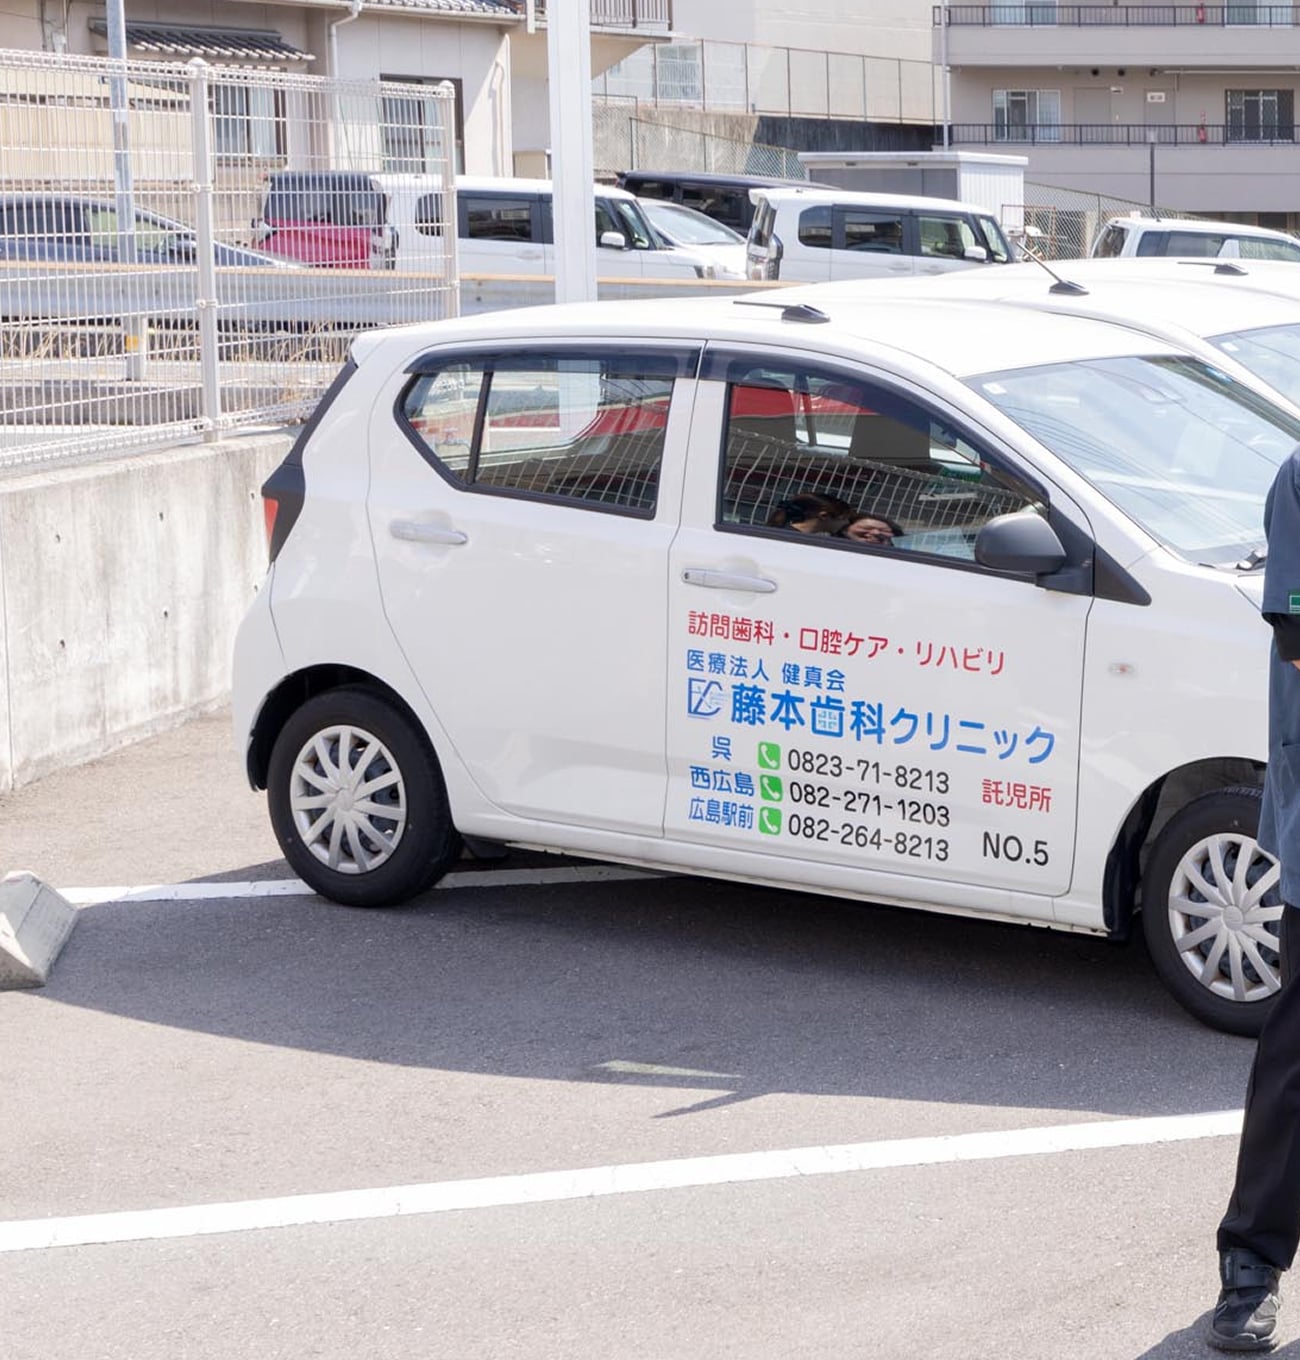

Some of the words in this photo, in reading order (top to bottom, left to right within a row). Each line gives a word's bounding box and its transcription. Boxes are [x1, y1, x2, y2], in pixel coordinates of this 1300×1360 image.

[687, 649, 770, 682] 医療法人
[781, 663, 846, 692] 健真会
[688, 611, 1005, 675] 訪問歯科・口腔ケア・リハビリ
[731, 683, 1056, 764] 藤本歯科クリニック
[712, 735, 732, 761] 呉
[788, 749, 949, 793] 0823-71-8213
[690, 766, 755, 797] 西広島
[789, 782, 950, 827] 082-271-1203
[982, 779, 1052, 812] 託児所
[688, 797, 754, 830] 広島駅前
[788, 814, 949, 861] 082-264-8213
[983, 831, 1049, 866] NO.5
